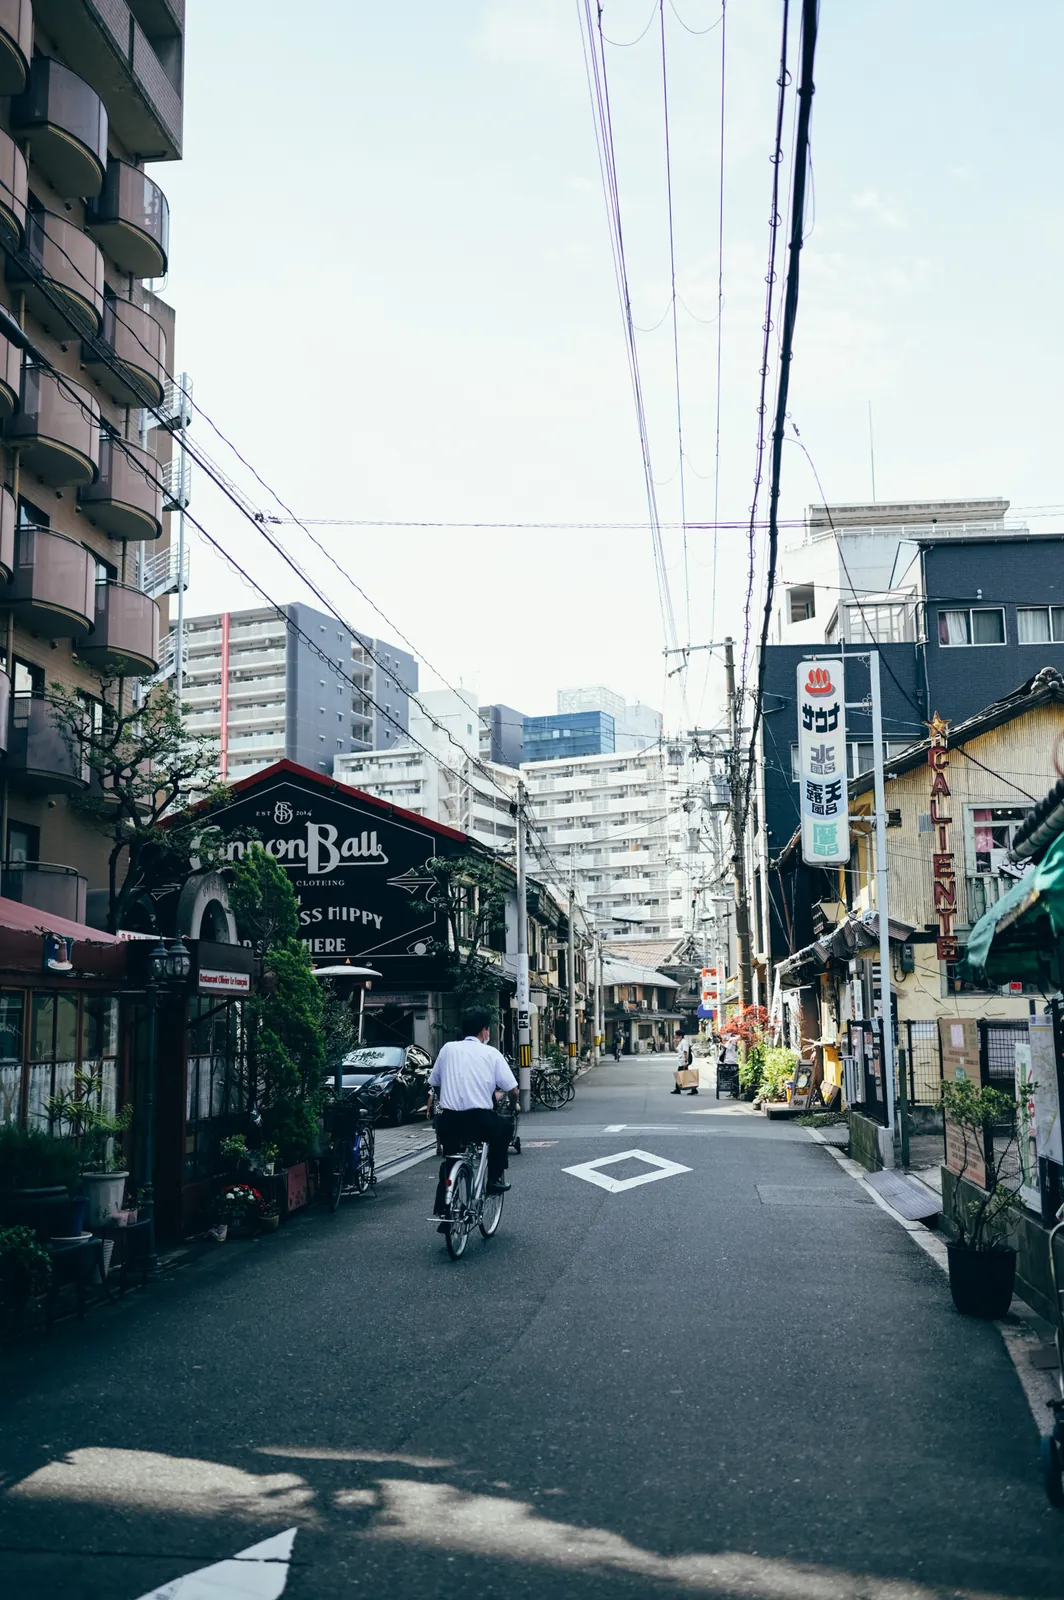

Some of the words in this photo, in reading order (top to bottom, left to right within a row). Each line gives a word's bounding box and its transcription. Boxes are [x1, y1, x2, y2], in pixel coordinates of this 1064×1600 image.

[802, 702, 840, 733] サウナ
[810, 744, 835, 764] 水
[928, 745, 958, 960] CALIENTE
[296, 879, 345, 887] CLOTHING
[328, 906, 383, 930] HIPPY
